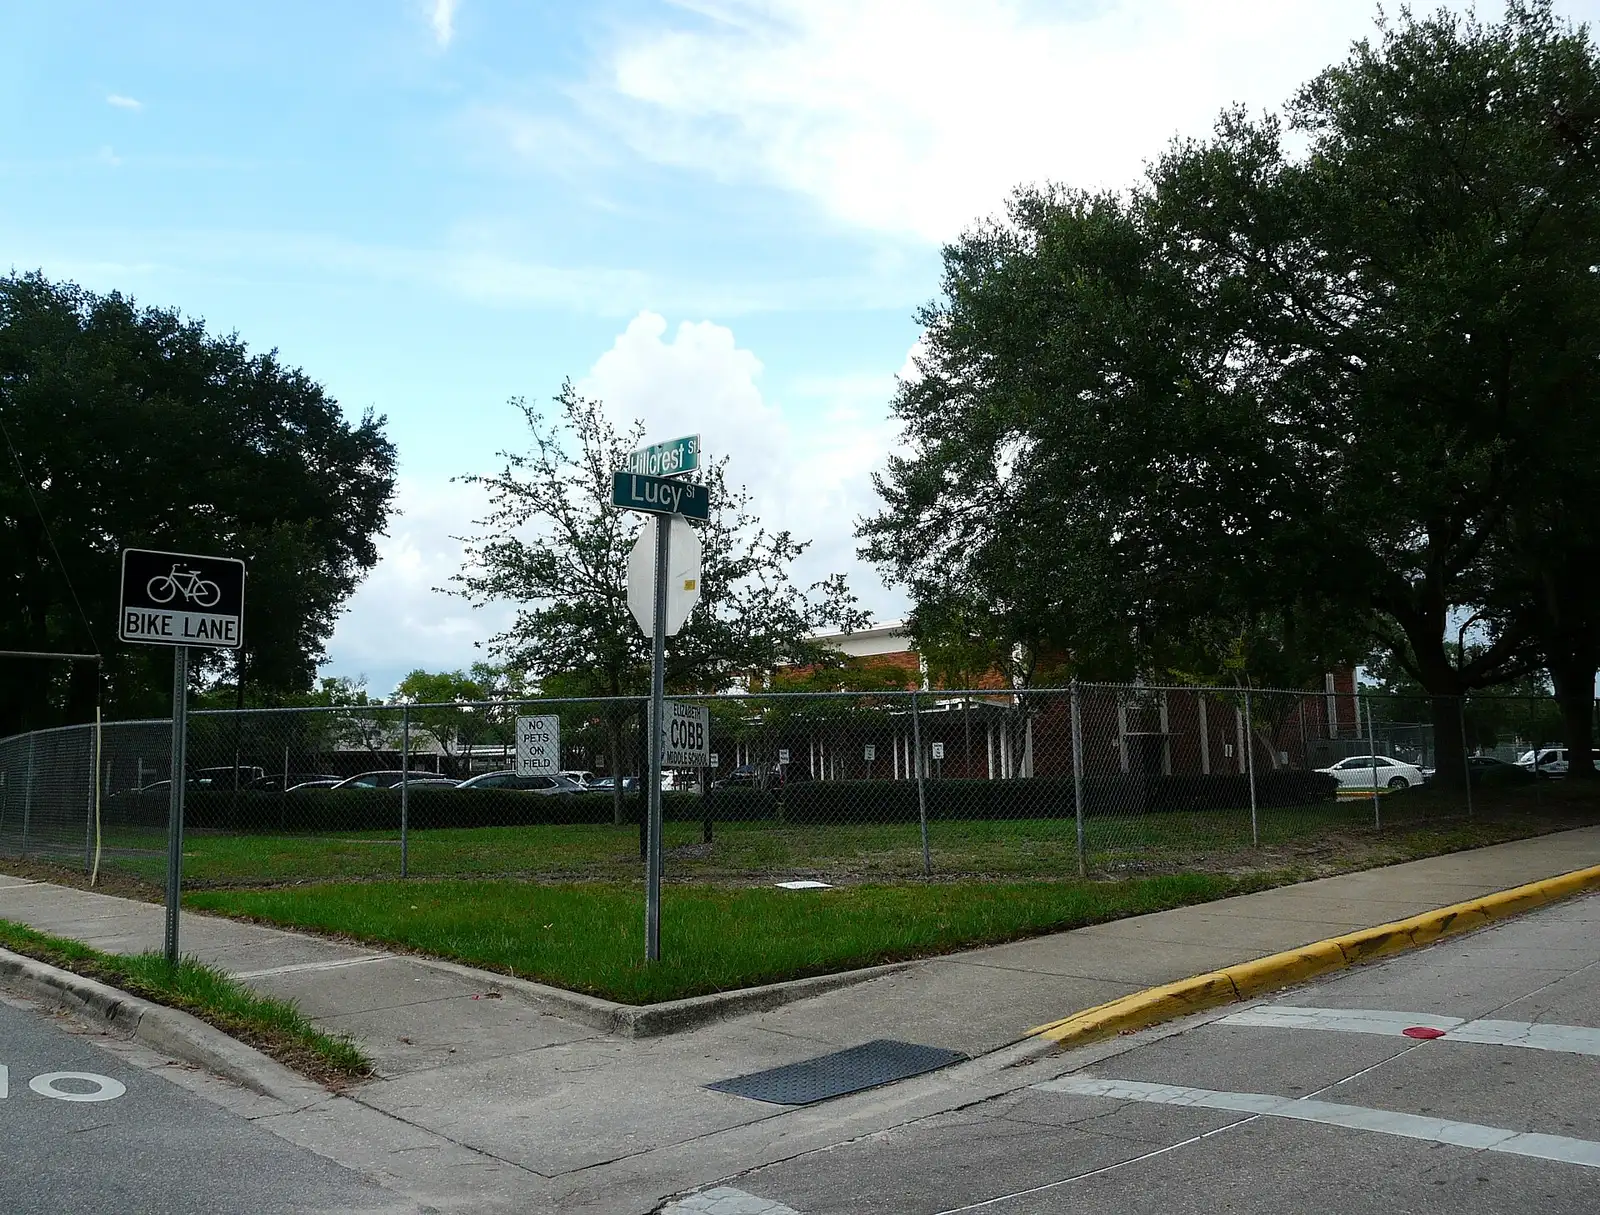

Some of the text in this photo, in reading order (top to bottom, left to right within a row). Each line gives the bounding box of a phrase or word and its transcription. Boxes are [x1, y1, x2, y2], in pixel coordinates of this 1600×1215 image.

[631, 444, 684, 474] Hillcrest
[632, 475, 695, 512] Lucy St
[126, 612, 235, 640] BIKE LANE
[529, 721, 544, 730] NO
[671, 719, 703, 750] COBB
[524, 733, 549, 742] PETS
[530, 746, 544, 756] ON
[524, 759, 550, 768] FIELD
